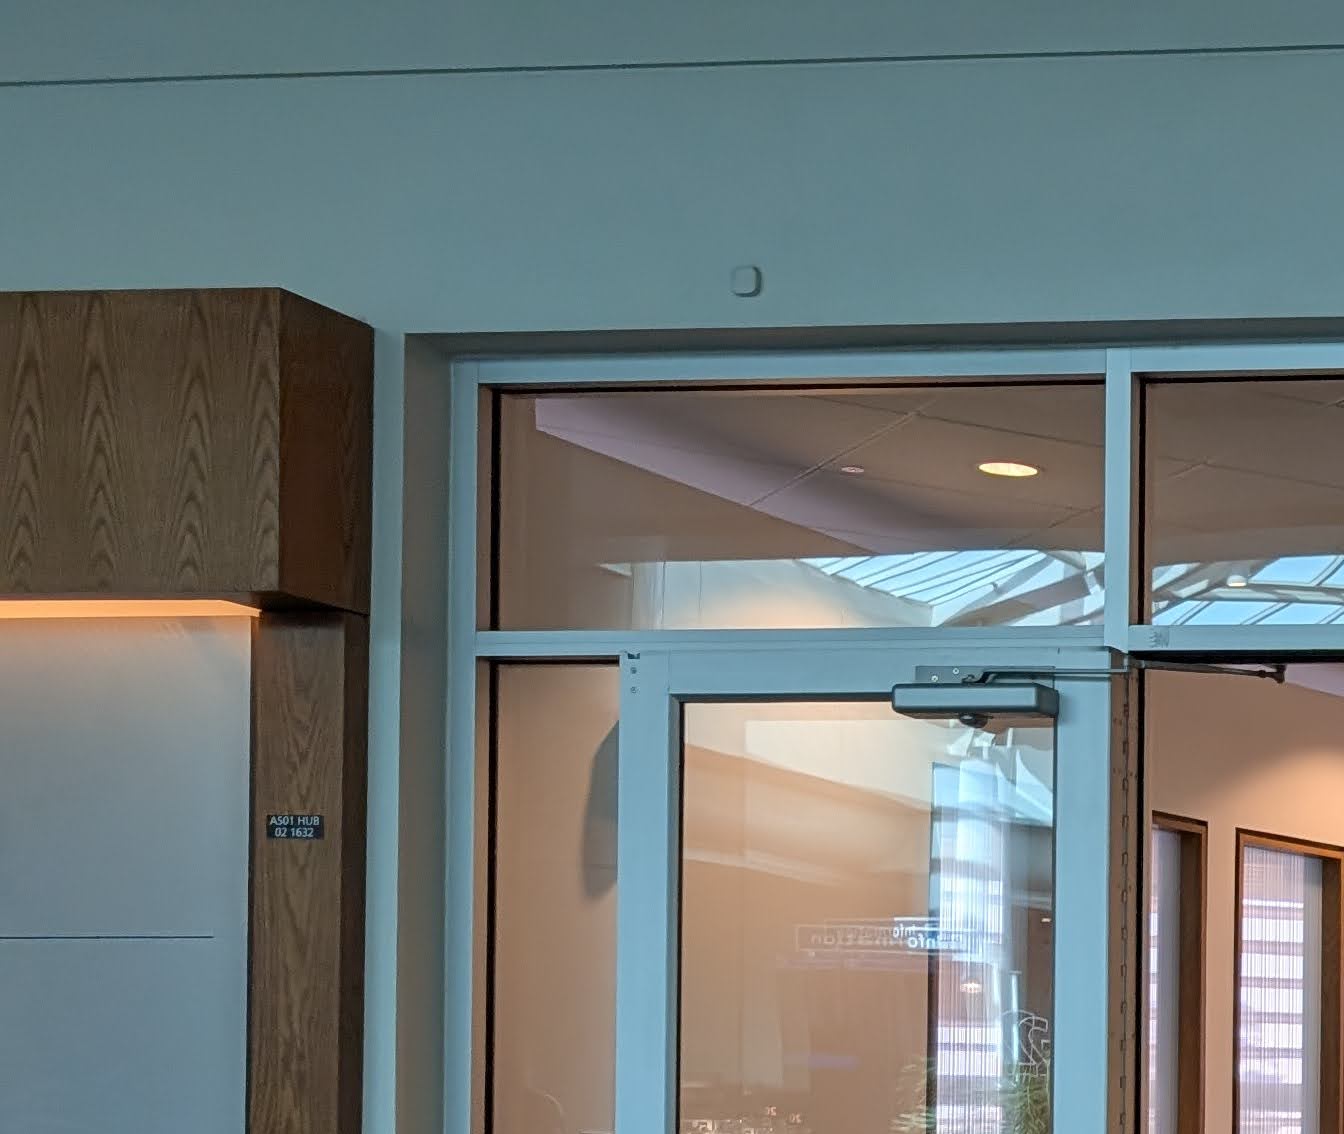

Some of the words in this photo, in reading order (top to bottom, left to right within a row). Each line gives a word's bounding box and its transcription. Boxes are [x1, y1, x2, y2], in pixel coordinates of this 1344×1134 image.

[297, 815, 320, 826] HUB
[274, 827, 288, 838] 02
[290, 827, 314, 838] 1632
